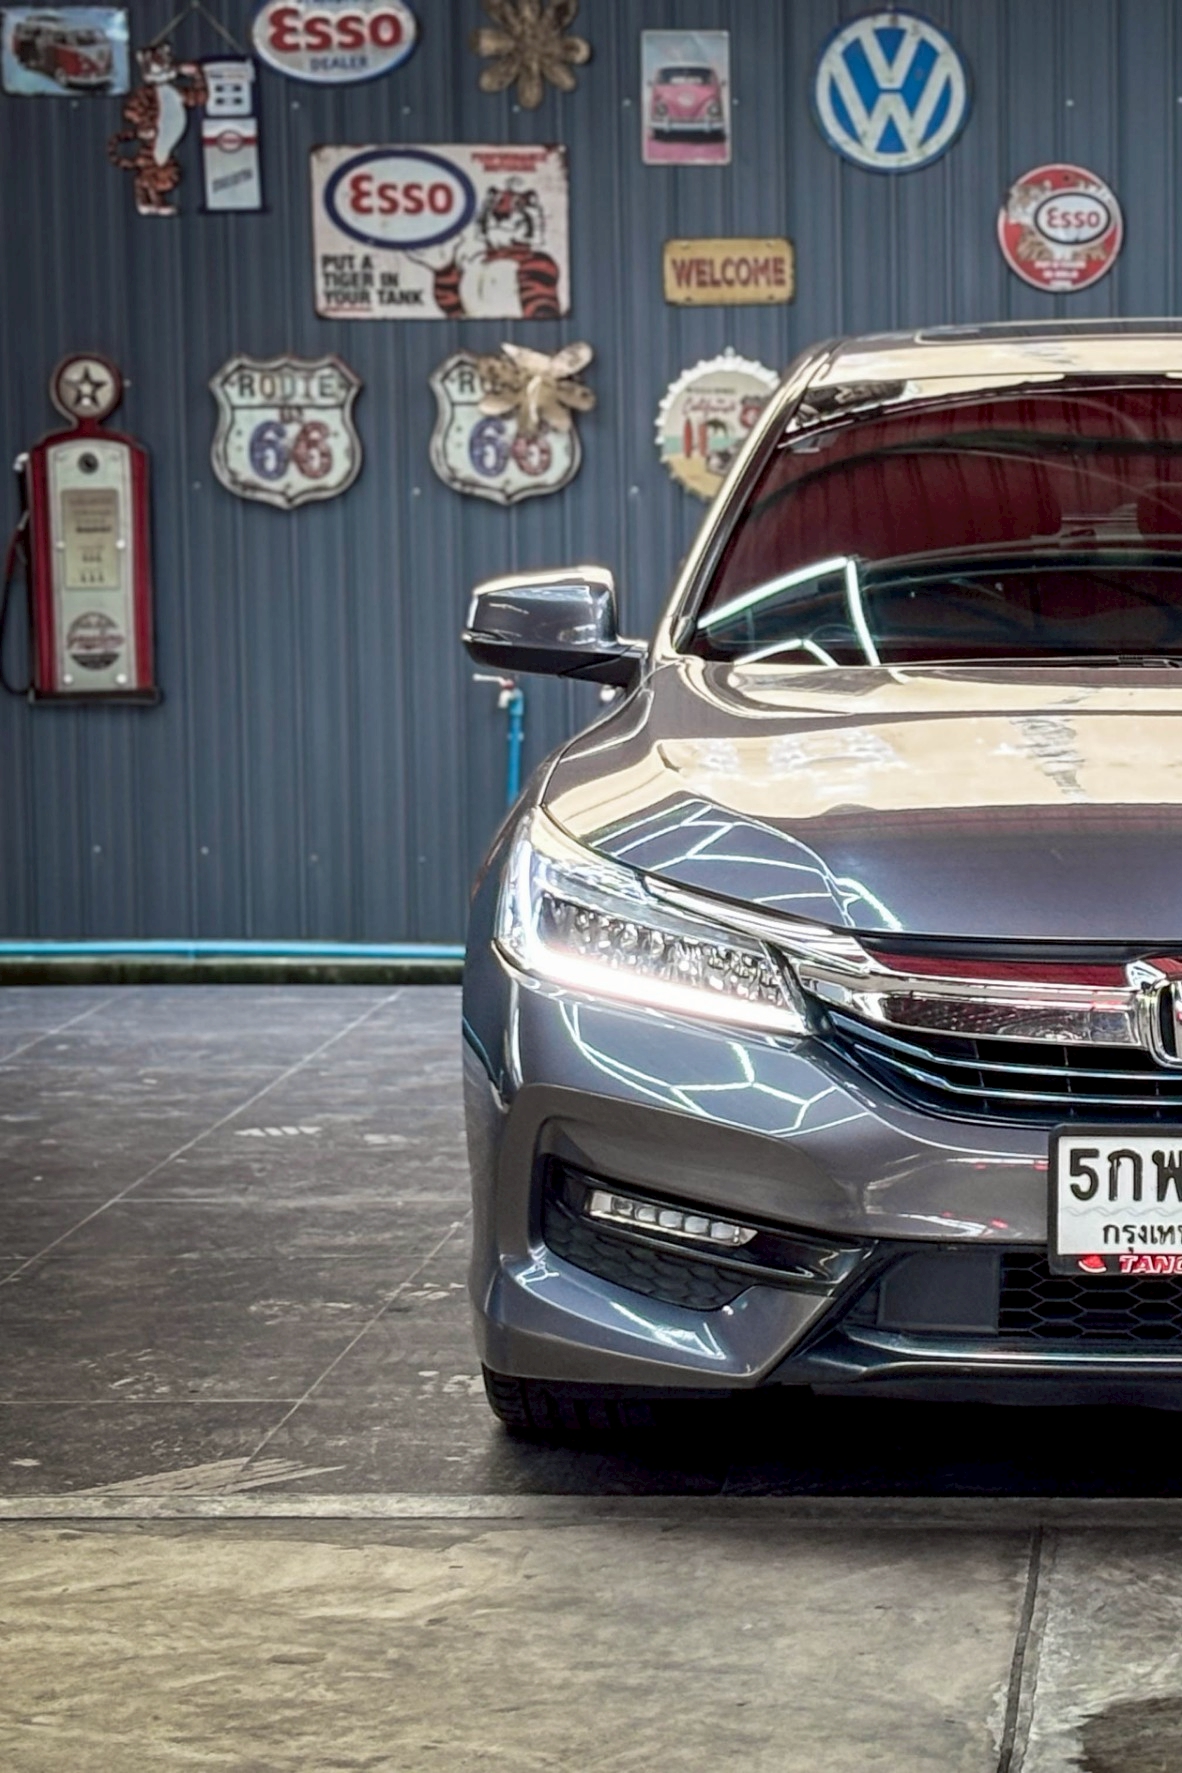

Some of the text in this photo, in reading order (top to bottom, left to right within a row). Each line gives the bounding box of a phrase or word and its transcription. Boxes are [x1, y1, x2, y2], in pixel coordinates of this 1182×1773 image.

[309, 56, 368, 71] DEALER
[321, 255, 374, 269] PUT A
[323, 272, 399, 287] TIGER IN
[672, 257, 786, 288] WELCOME
[323, 290, 424, 305] YOUR TANK
[239, 374, 336, 399] ROUTE
[249, 420, 334, 480] 66
